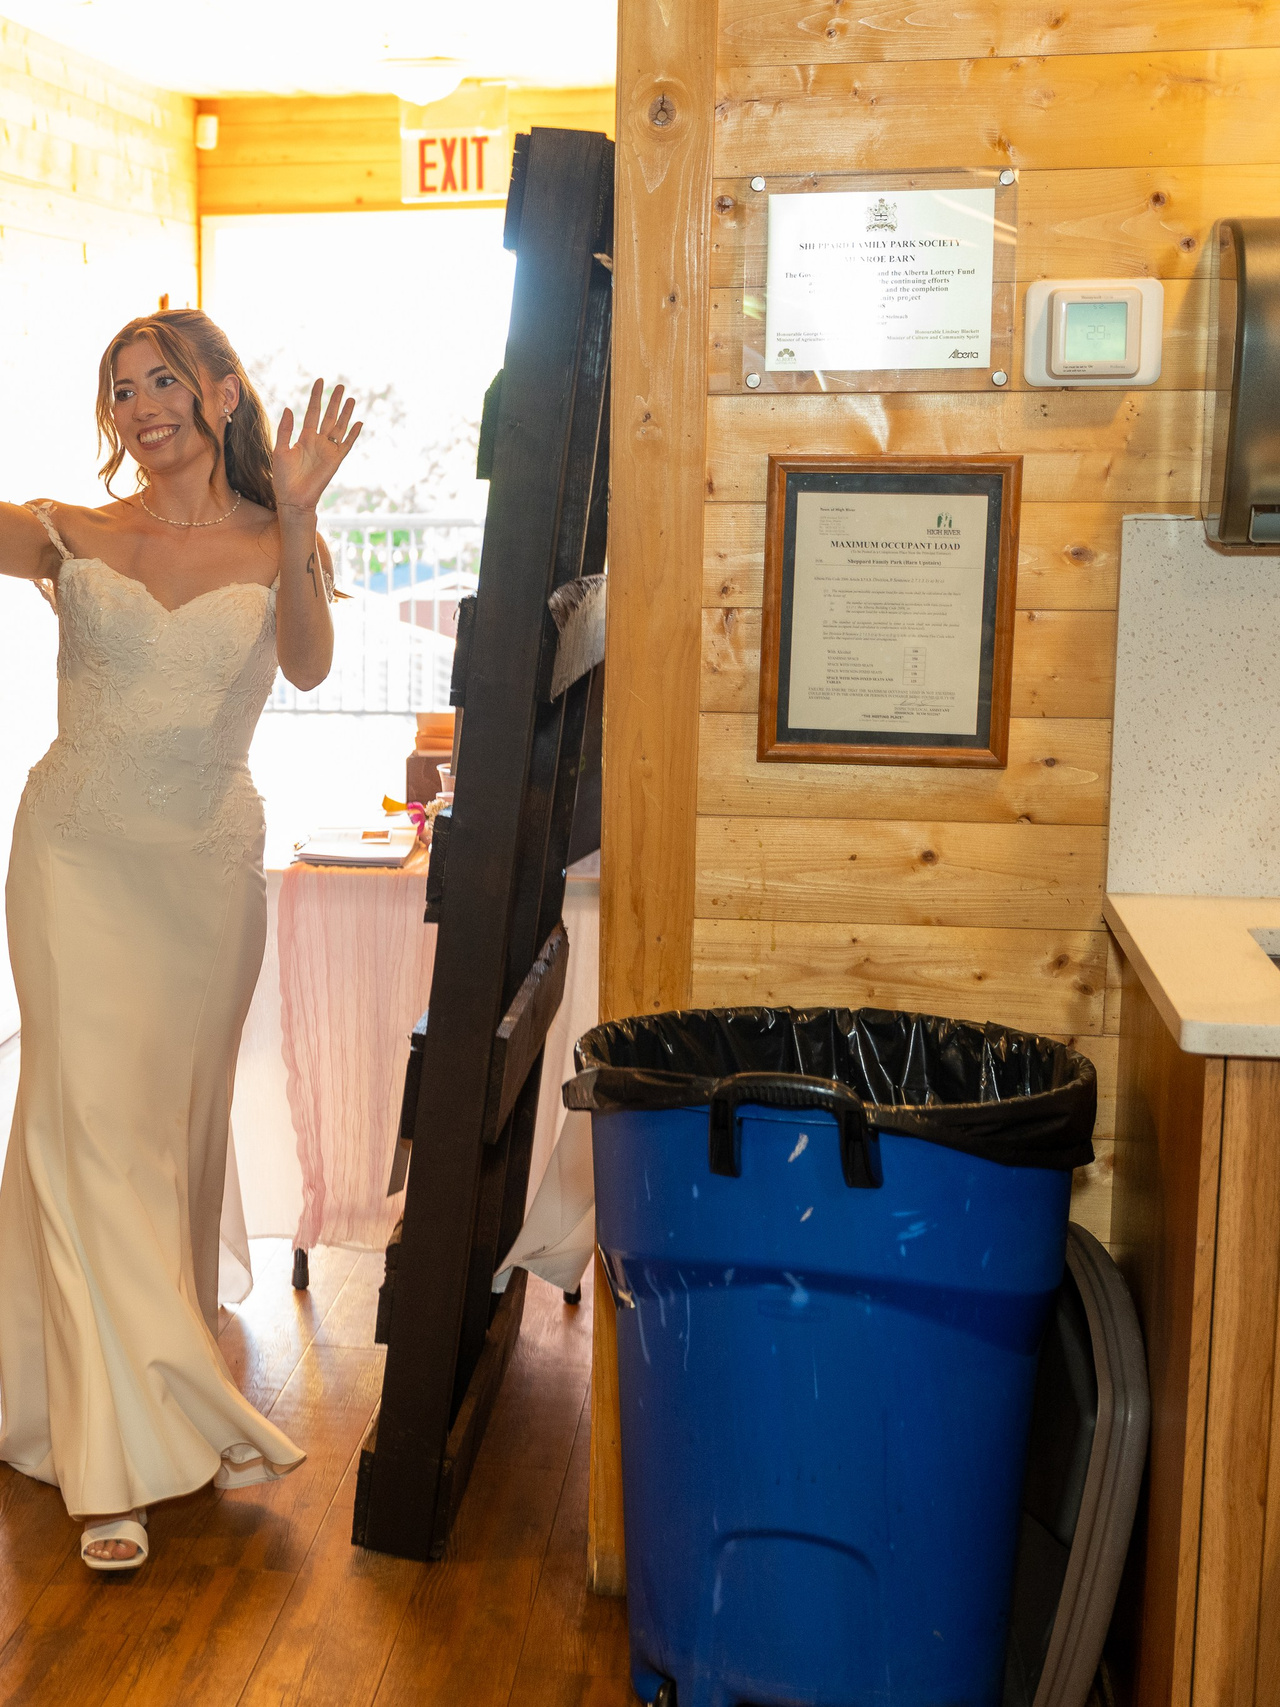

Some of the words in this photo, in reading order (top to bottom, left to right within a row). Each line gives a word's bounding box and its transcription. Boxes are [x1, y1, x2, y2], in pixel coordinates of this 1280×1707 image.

[419, 136, 489, 193] EXIT
[891, 240, 916, 248] PARK
[918, 239, 961, 248] SOCIETY
[889, 255, 916, 263] BARN
[930, 269, 955, 277] Lottery
[911, 285, 949, 293] completion
[948, 349, 979, 359] Alberta
[830, 540, 879, 549] MAXIMUM
[881, 541, 932, 550] OCCUPANT
[934, 543, 961, 551] LOAD
